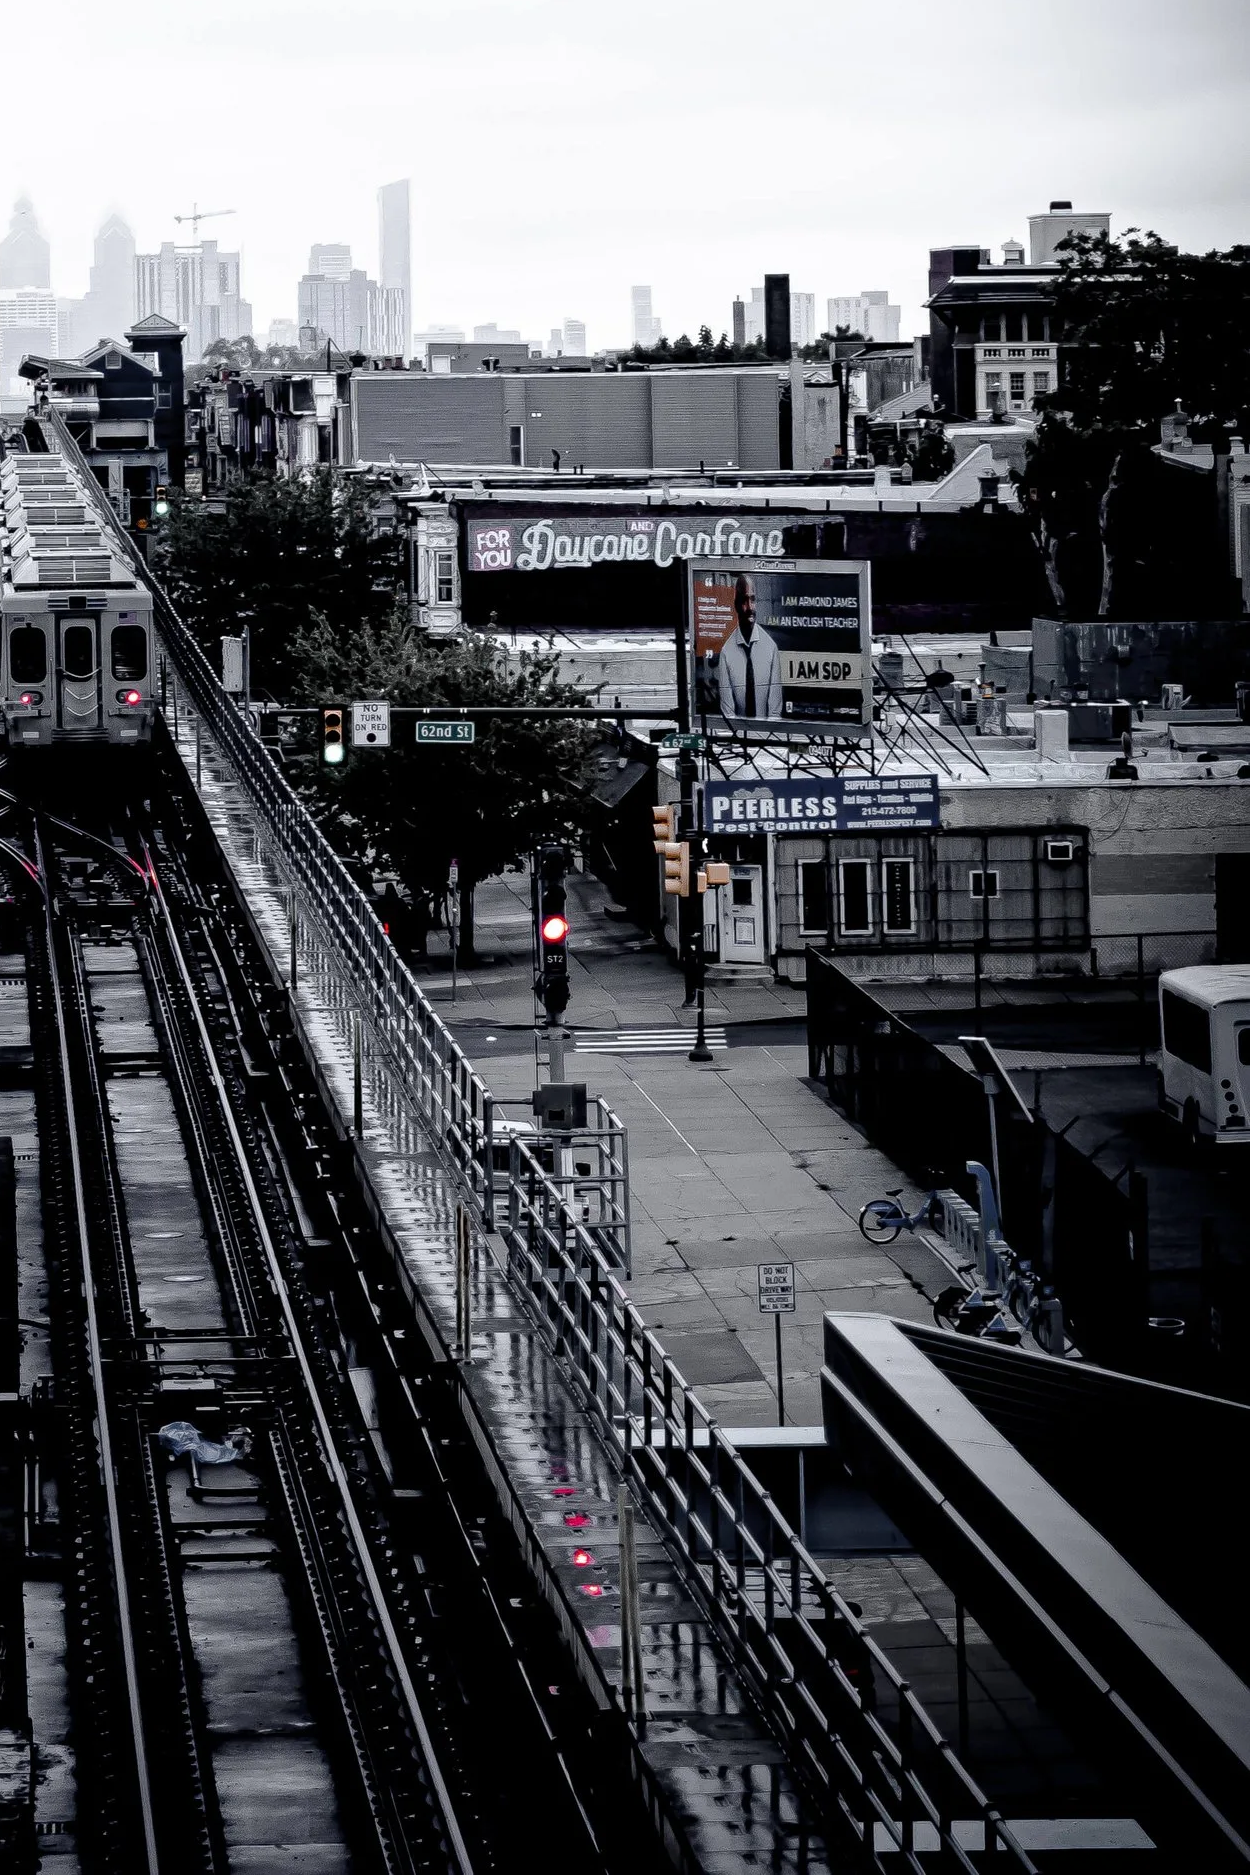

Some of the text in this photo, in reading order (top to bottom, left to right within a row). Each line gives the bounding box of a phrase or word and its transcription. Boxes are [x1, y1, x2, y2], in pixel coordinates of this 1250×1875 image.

[476, 529, 510, 550] FOR
[516, 519, 650, 570] Daycare
[475, 550, 511, 568] YOU
[785, 596, 797, 606] AM
[833, 597, 857, 607] JAMES
[780, 617, 791, 626] AN
[792, 617, 823, 627] ENGLISH
[824, 618, 858, 628] TEACHER
[797, 661, 819, 679] AM
[822, 662, 851, 680] SDP
[363, 704, 378, 712] NO
[421, 726, 469, 737] 62nd St
[844, 780, 881, 790] SUPPLIES
[900, 778, 932, 789] SERVICE
[712, 796, 837, 820] PEERLESS
[713, 820, 837, 833] Pest Control
[547, 955, 563, 963] ST2
[775, 1266, 788, 1274] NOT
[766, 1276, 787, 1284] BLOCK
